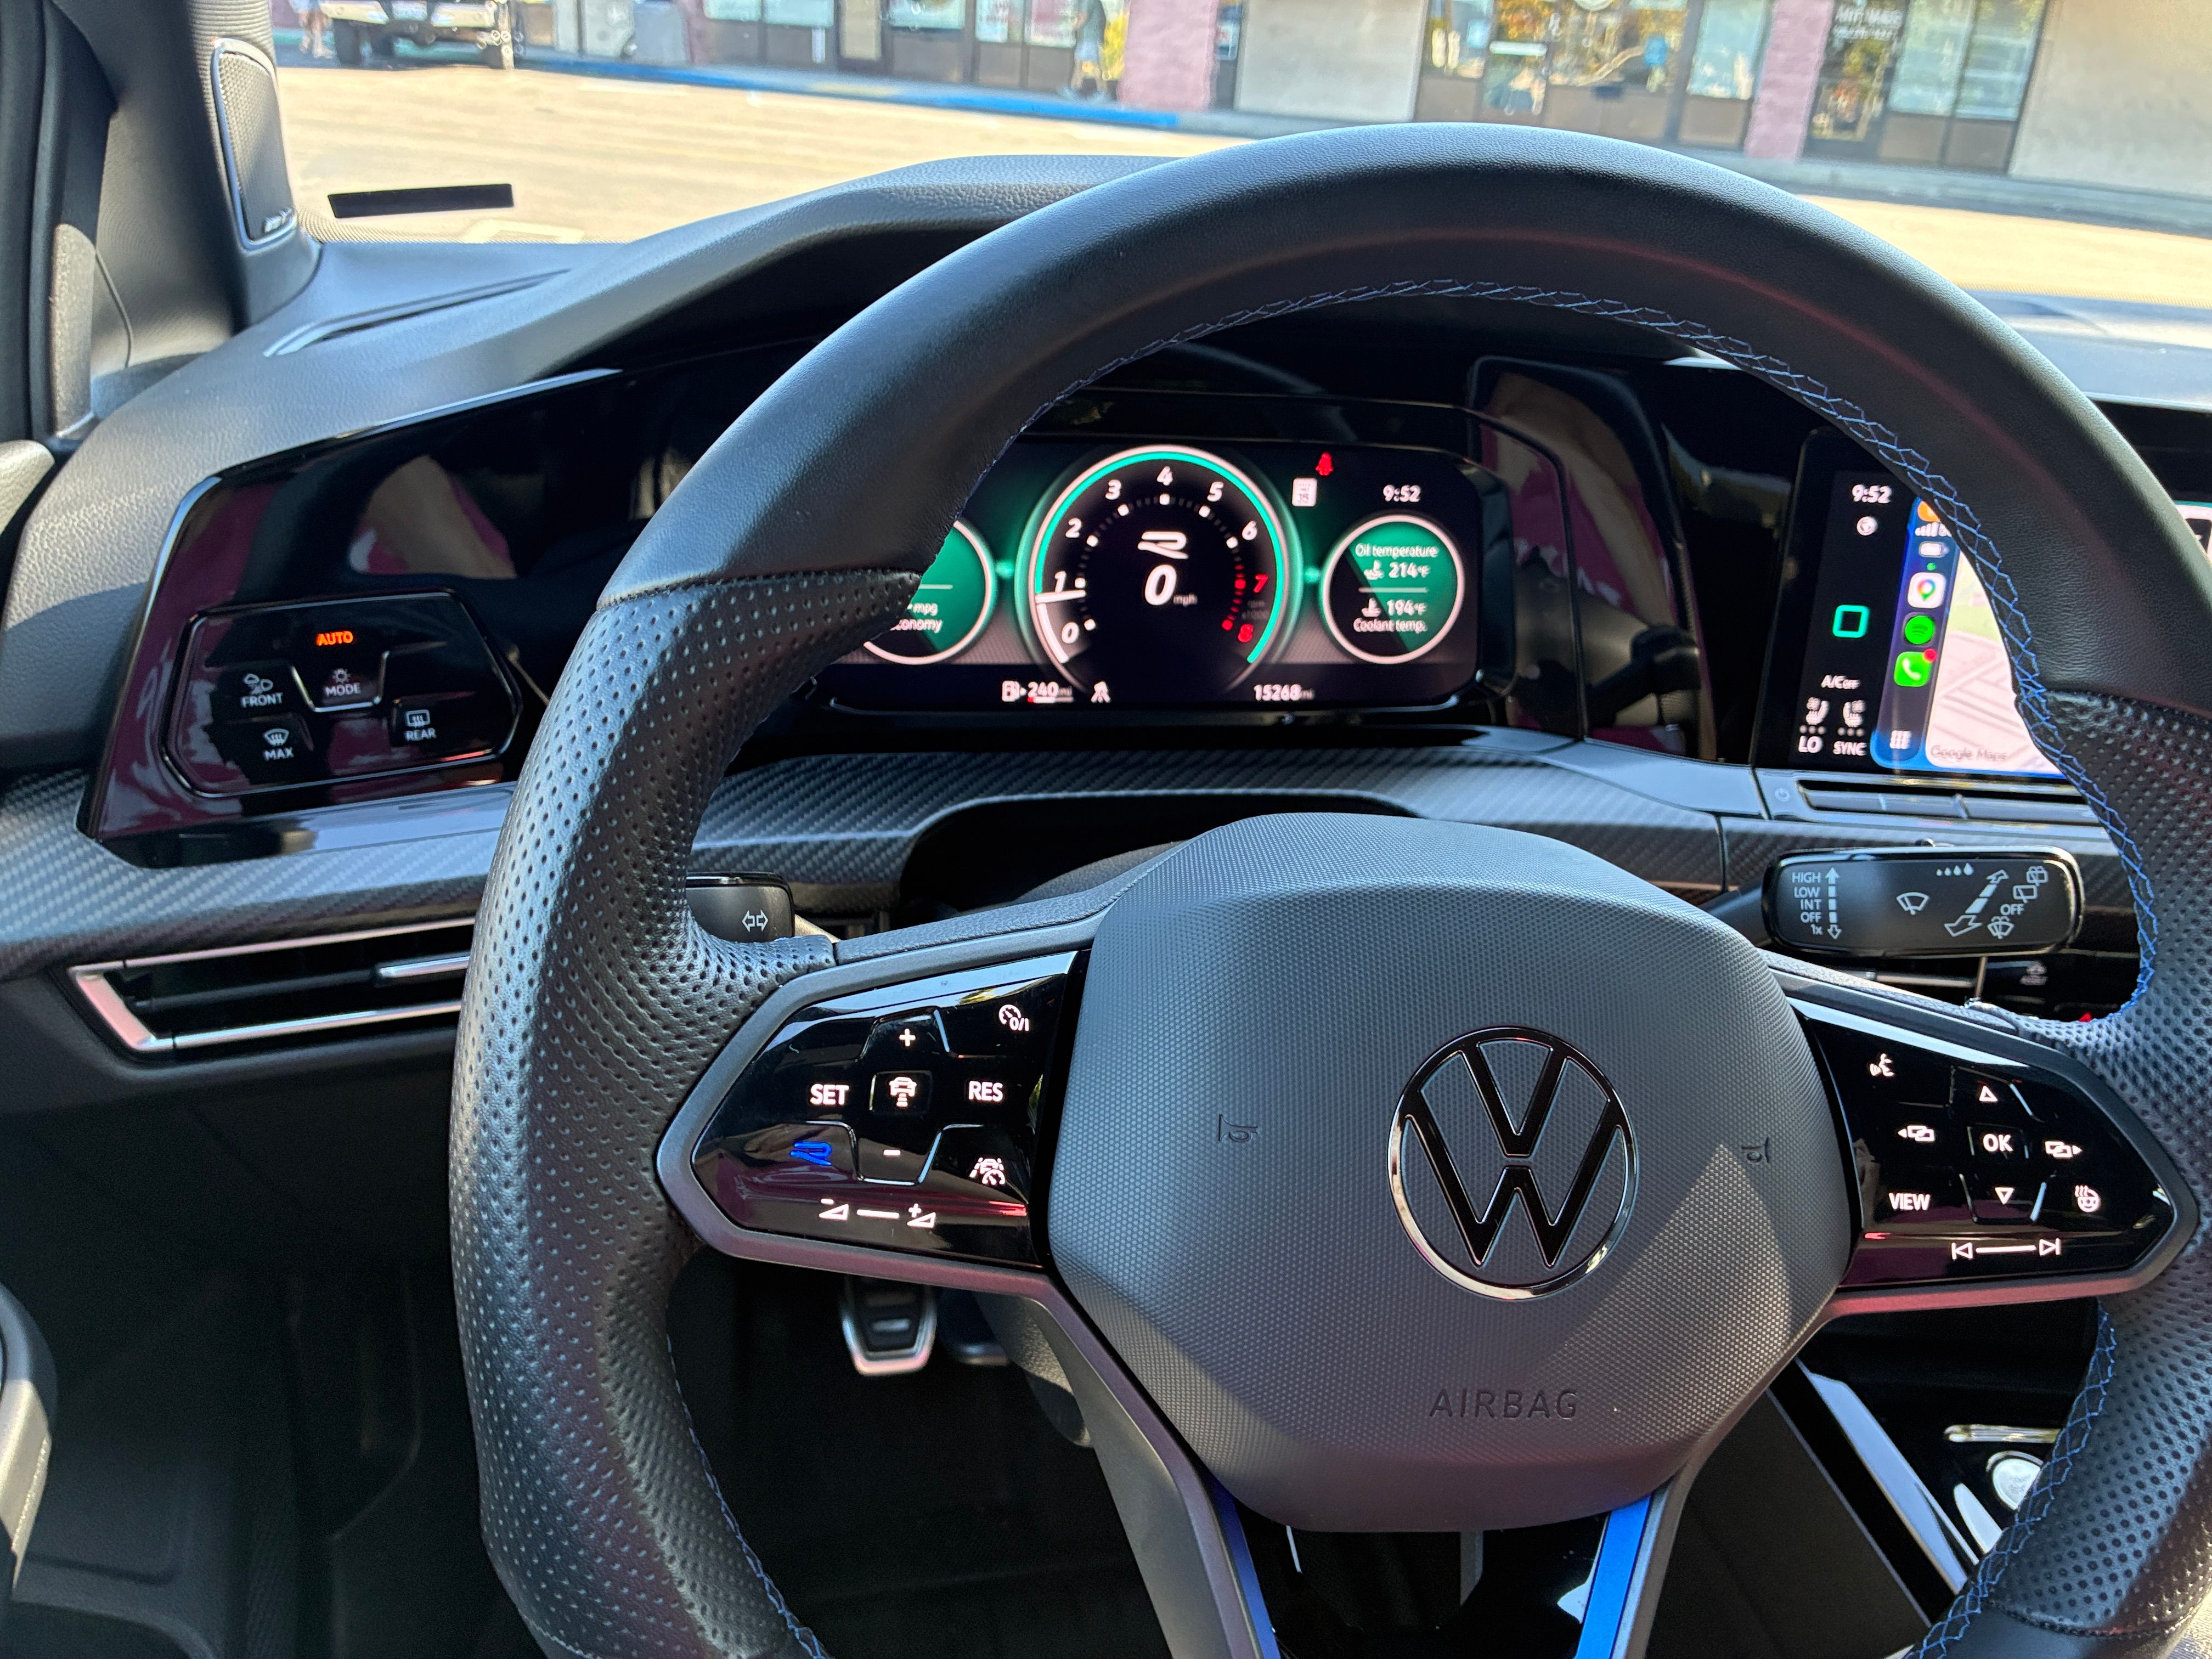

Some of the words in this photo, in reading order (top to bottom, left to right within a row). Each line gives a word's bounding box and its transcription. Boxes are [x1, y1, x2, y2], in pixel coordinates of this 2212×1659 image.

[1157, 466, 1173, 486] 4
[1105, 479, 1122, 500] 3
[1207, 482, 1224, 502] 5
[1383, 484, 1421, 503] 9:52
[1852, 484, 1892, 504] 9:52
[1065, 518, 1082, 538] 2
[1242, 521, 1257, 541] 6
[1355, 543, 1371, 557] Oil
[1372, 545, 1439, 559] temperature
[1054, 571, 1067, 592] 1
[1144, 565, 1177, 606] 0
[1173, 592, 1198, 607] mph
[1254, 574, 1268, 593] 7
[913, 603, 938, 616] mpg
[1061, 622, 1080, 644] 0
[1238, 623, 1254, 643] 8
[1353, 617, 1395, 632] Coolant
[1396, 619, 1427, 634] temp.
[315, 630, 354, 646] AUTO
[325, 683, 361, 697] MODE
[1028, 681, 1059, 696] 240
[1821, 675, 1844, 689] A/C
[240, 692, 283, 708] FRONT
[1254, 684, 1301, 701] 15268
[404, 728, 437, 742] REAR
[1798, 736, 1822, 753] LO
[1833, 741, 1867, 756] SYNC
[263, 747, 294, 761] MAX
[1931, 745, 1972, 762] Google
[1976, 748, 2006, 761] Maps
[1792, 872, 1821, 884] HIGH
[1794, 887, 1819, 898] LOW
[1801, 899, 1821, 910] INT
[2000, 904, 2024, 916] OFF
[1801, 911, 1821, 923] OFF
[1810, 924, 1823, 935] 1x
[810, 1084, 849, 1105] SET
[968, 1081, 1003, 1102] RES
[1983, 1134, 2013, 1152] OK
[1888, 1193, 1930, 1211] VIEW
[1429, 1389, 1578, 1419] AIRBAG
